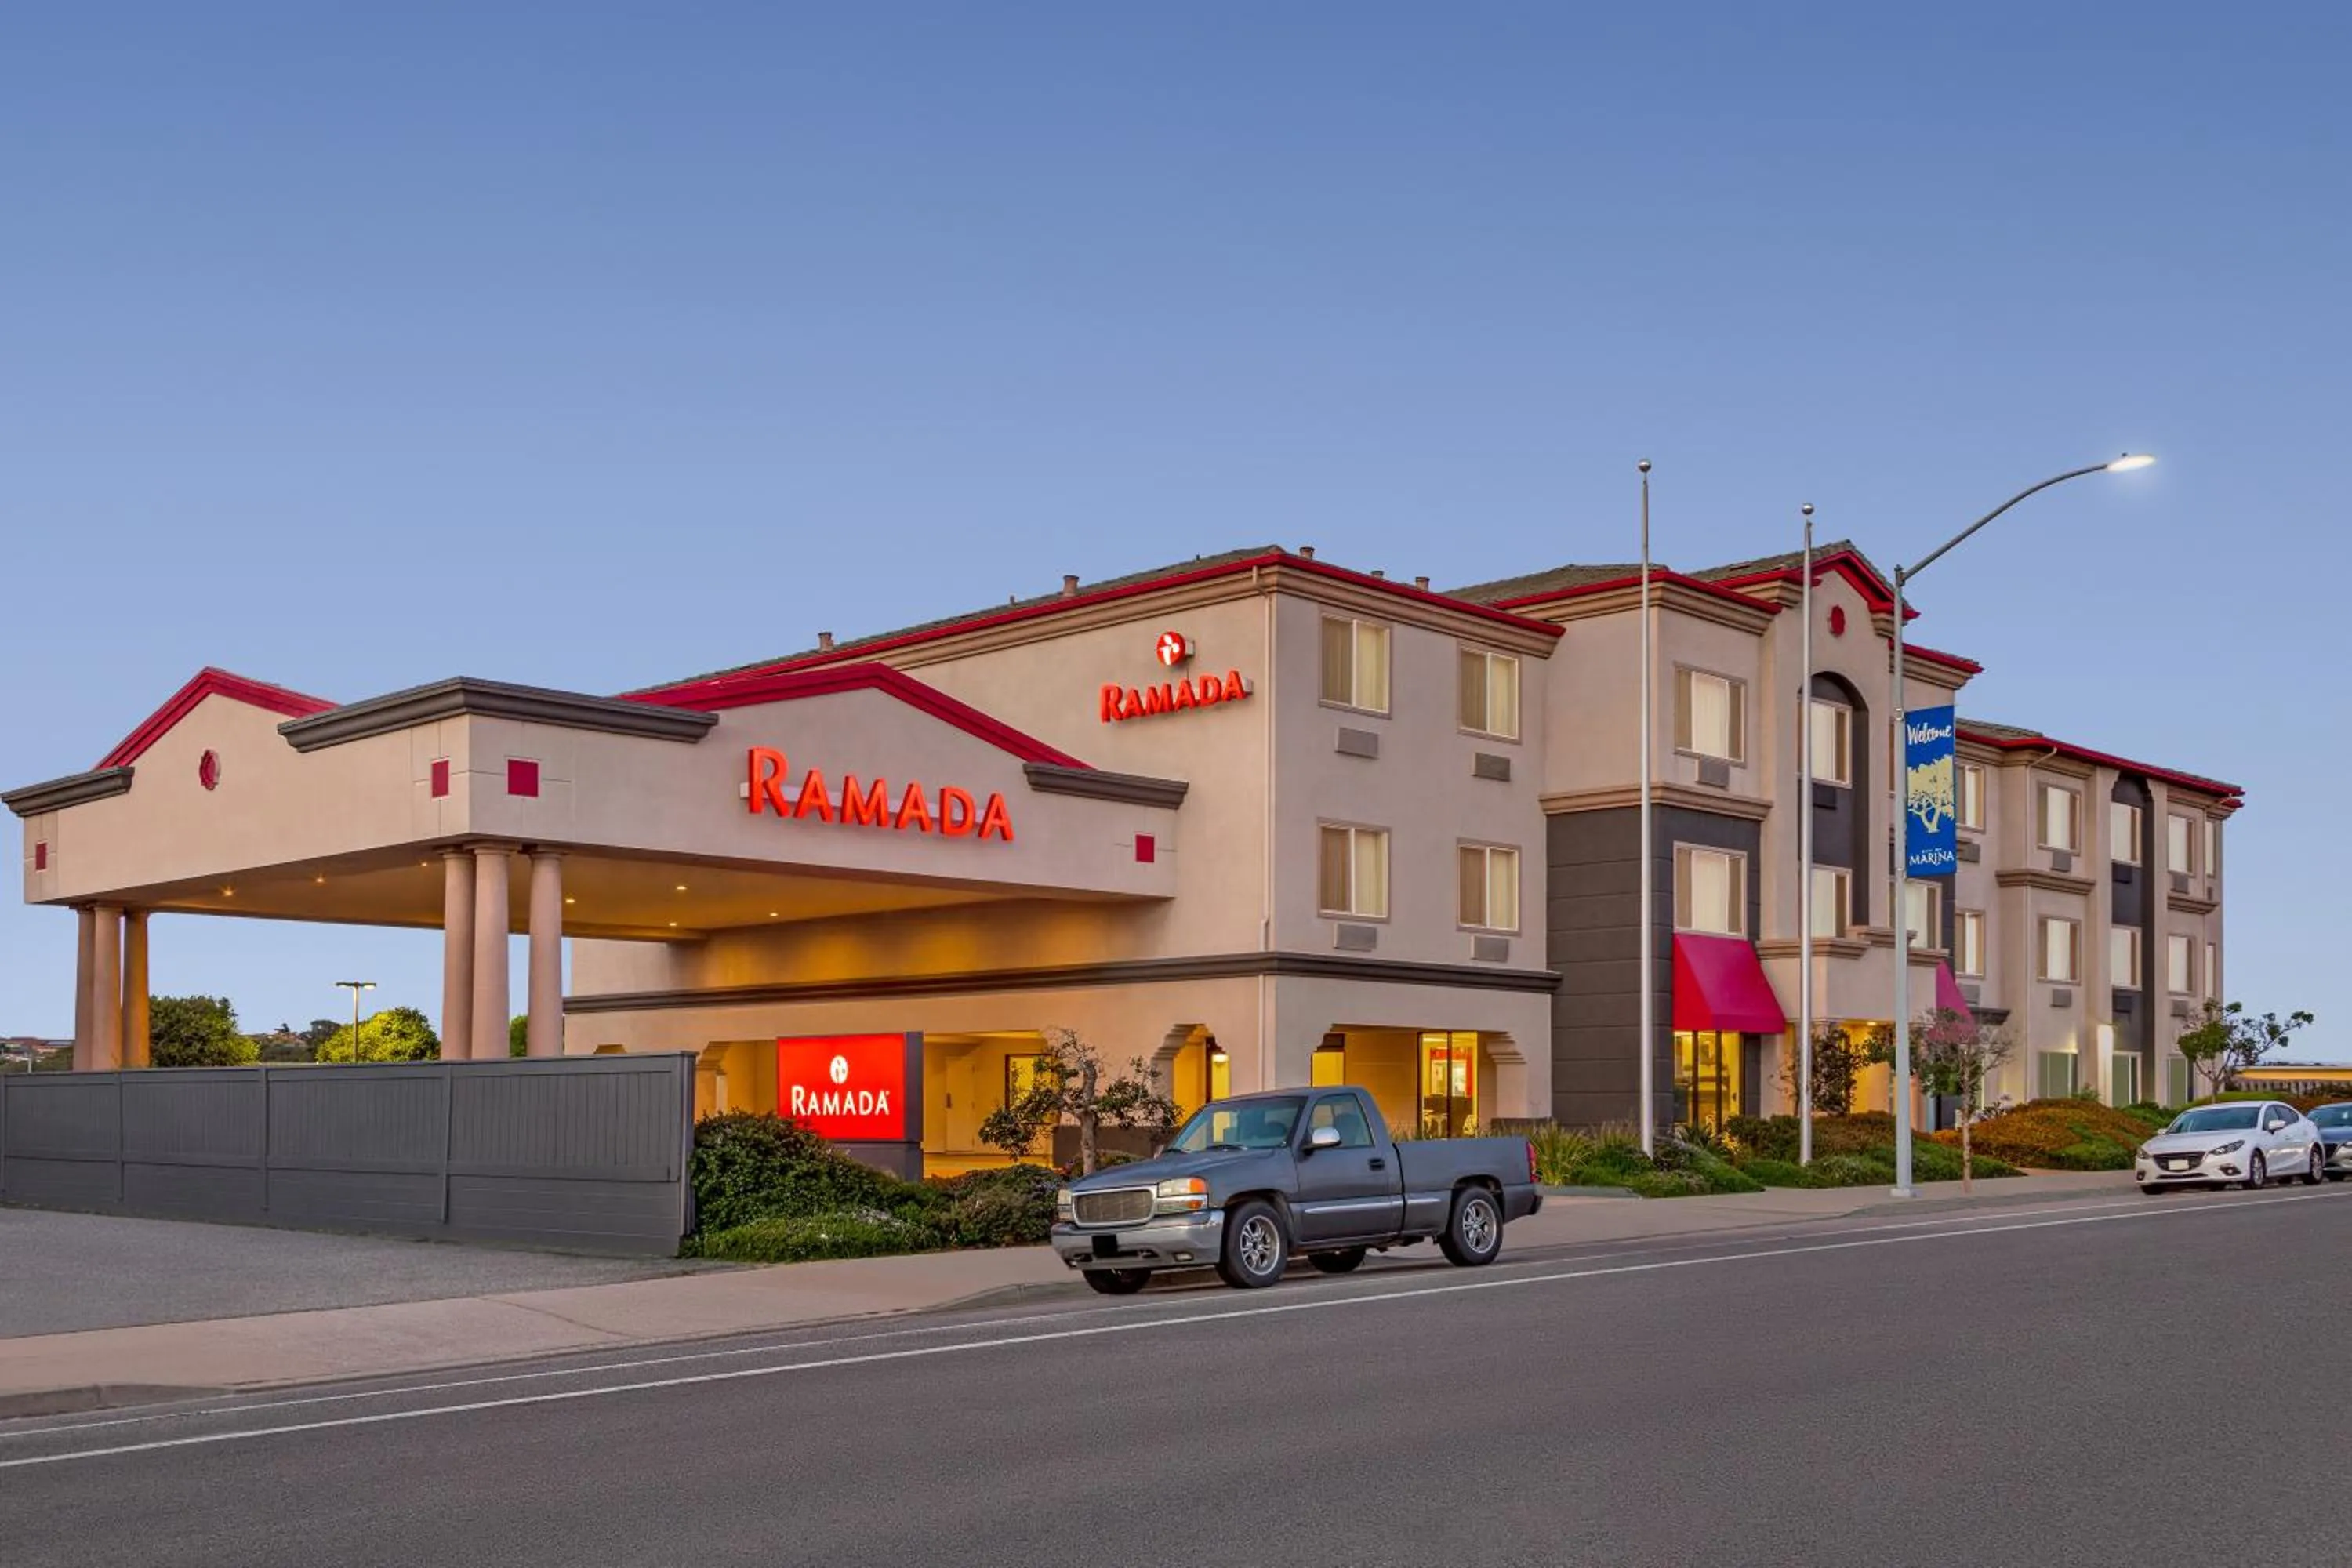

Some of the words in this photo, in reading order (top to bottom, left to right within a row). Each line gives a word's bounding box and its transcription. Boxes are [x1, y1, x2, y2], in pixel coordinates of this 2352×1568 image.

[1101, 670, 1247, 723] RAMADA
[1906, 722, 1951, 745] Welcome
[748, 746, 1014, 841] RAMADA
[1909, 851, 1954, 866] MARINA
[791, 1084, 890, 1116] RAMADA
